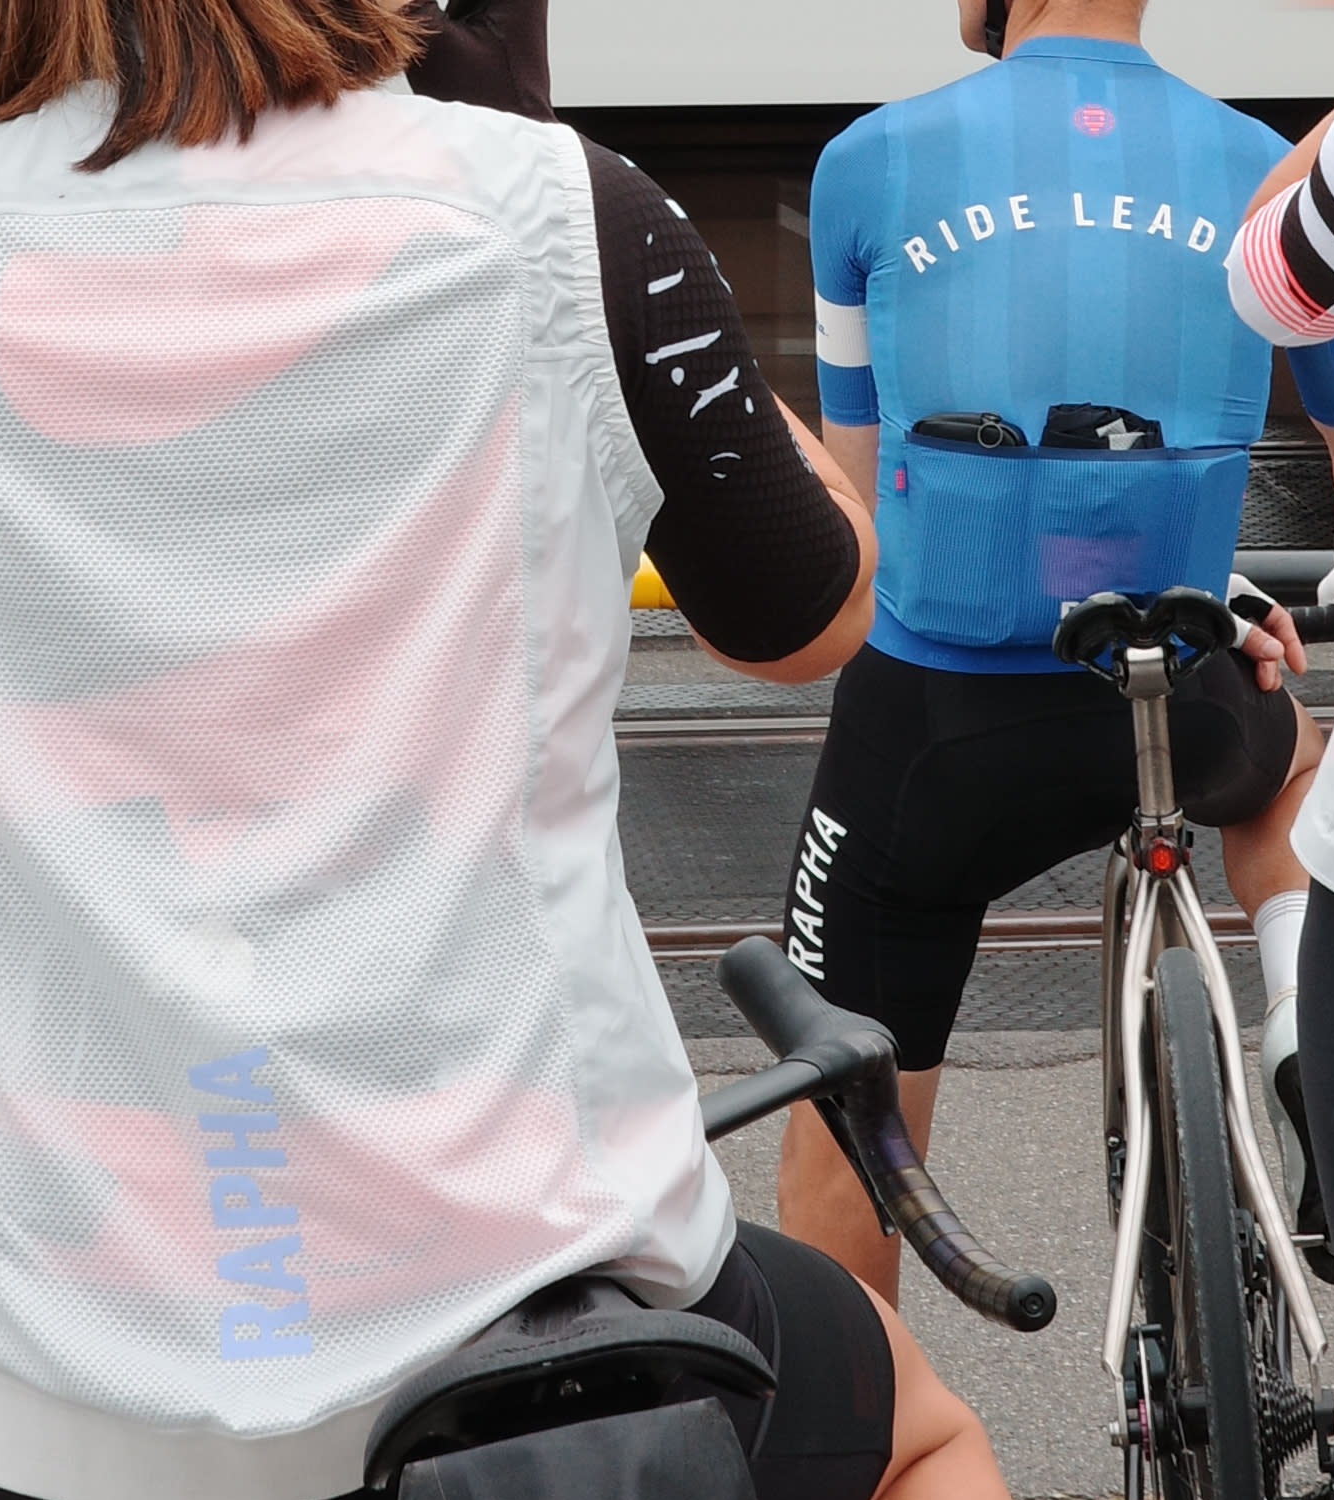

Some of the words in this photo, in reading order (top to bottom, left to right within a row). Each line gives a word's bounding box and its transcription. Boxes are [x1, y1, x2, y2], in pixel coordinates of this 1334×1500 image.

[903, 193, 1035, 274] RIDE
[1072, 191, 1231, 272] LEAD
[787, 806, 847, 981] RAPHA
[188, 1044, 313, 1360] RAPHA
